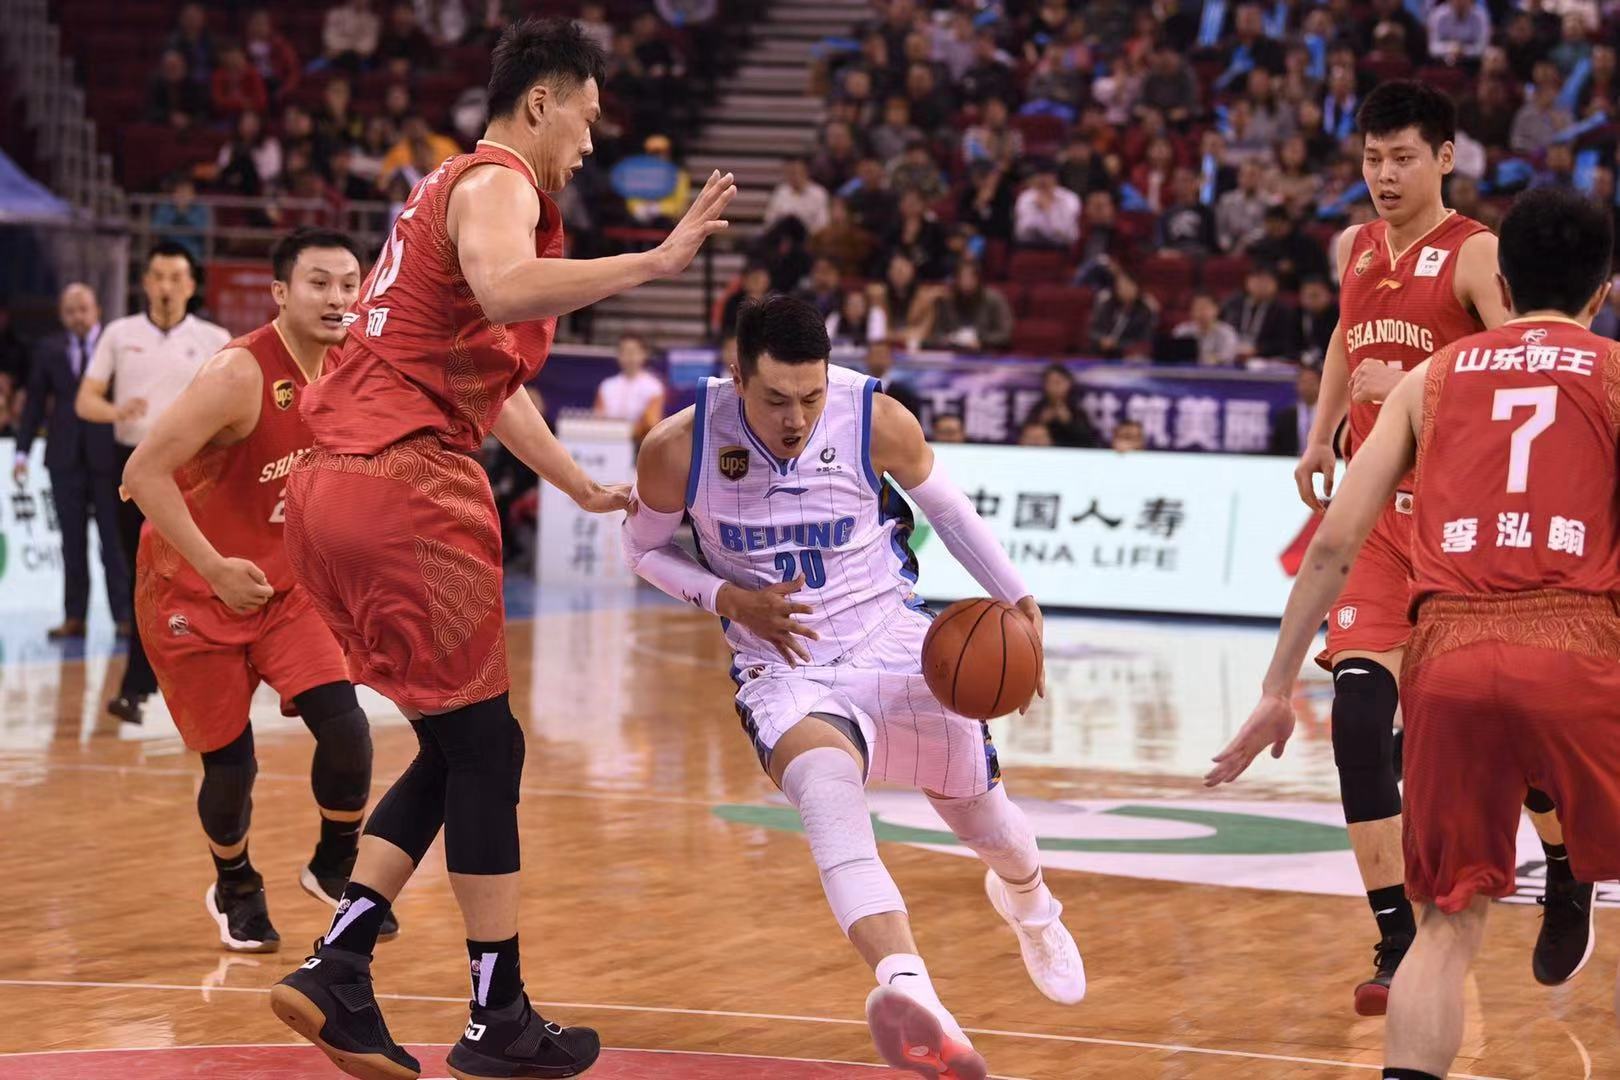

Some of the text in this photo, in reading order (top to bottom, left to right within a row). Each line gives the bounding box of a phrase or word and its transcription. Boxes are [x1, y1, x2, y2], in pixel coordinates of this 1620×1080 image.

[1347, 319, 1434, 353] SHANDONG
[1454, 345, 1596, 376] 山东西王
[276, 388, 293, 406] ups
[1491, 385, 1559, 494] 7
[721, 456, 746, 476] ups
[967, 489, 1185, 538] 中国人寿
[719, 516, 855, 554] BEIJING
[1441, 512, 1585, 557] 李泓翰
[774, 550, 827, 589] 20
[1004, 541, 1181, 571] INA LIFE
